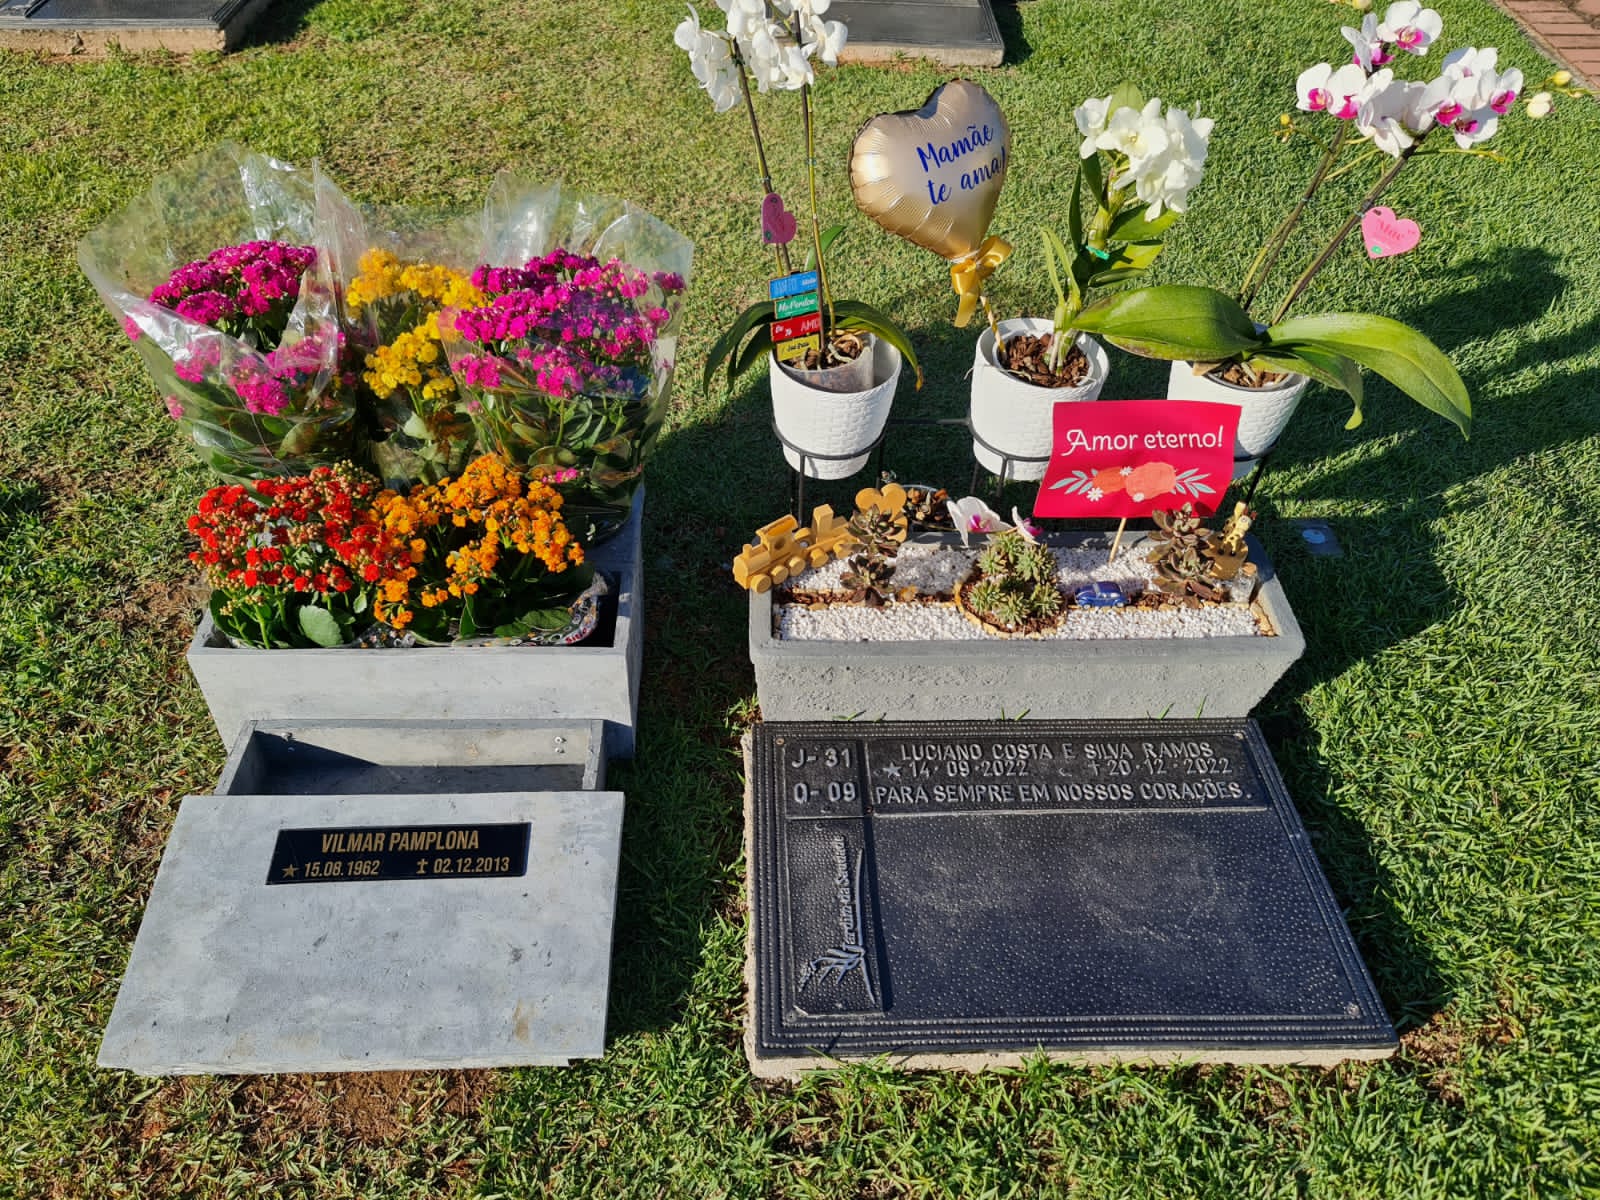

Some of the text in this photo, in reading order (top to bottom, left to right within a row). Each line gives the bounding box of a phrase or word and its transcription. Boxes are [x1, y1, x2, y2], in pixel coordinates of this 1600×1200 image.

[916, 124, 994, 173] Mamãe
[927, 179, 952, 205] te
[1061, 425, 1224, 457] Amor eterno!
[901, 742, 1214, 761] LUCIANO COSTA E SILVA RAMOS
[875, 785, 929, 804] PARA
[933, 784, 1015, 803] SEMPRE
[1019, 783, 1050, 802] EM
[1054, 782, 1134, 801] NOSSOS
[321, 830, 479, 854] VILMAR PAMPLONA
[304, 856, 510, 878] 15.08.1962 02.12.2013
